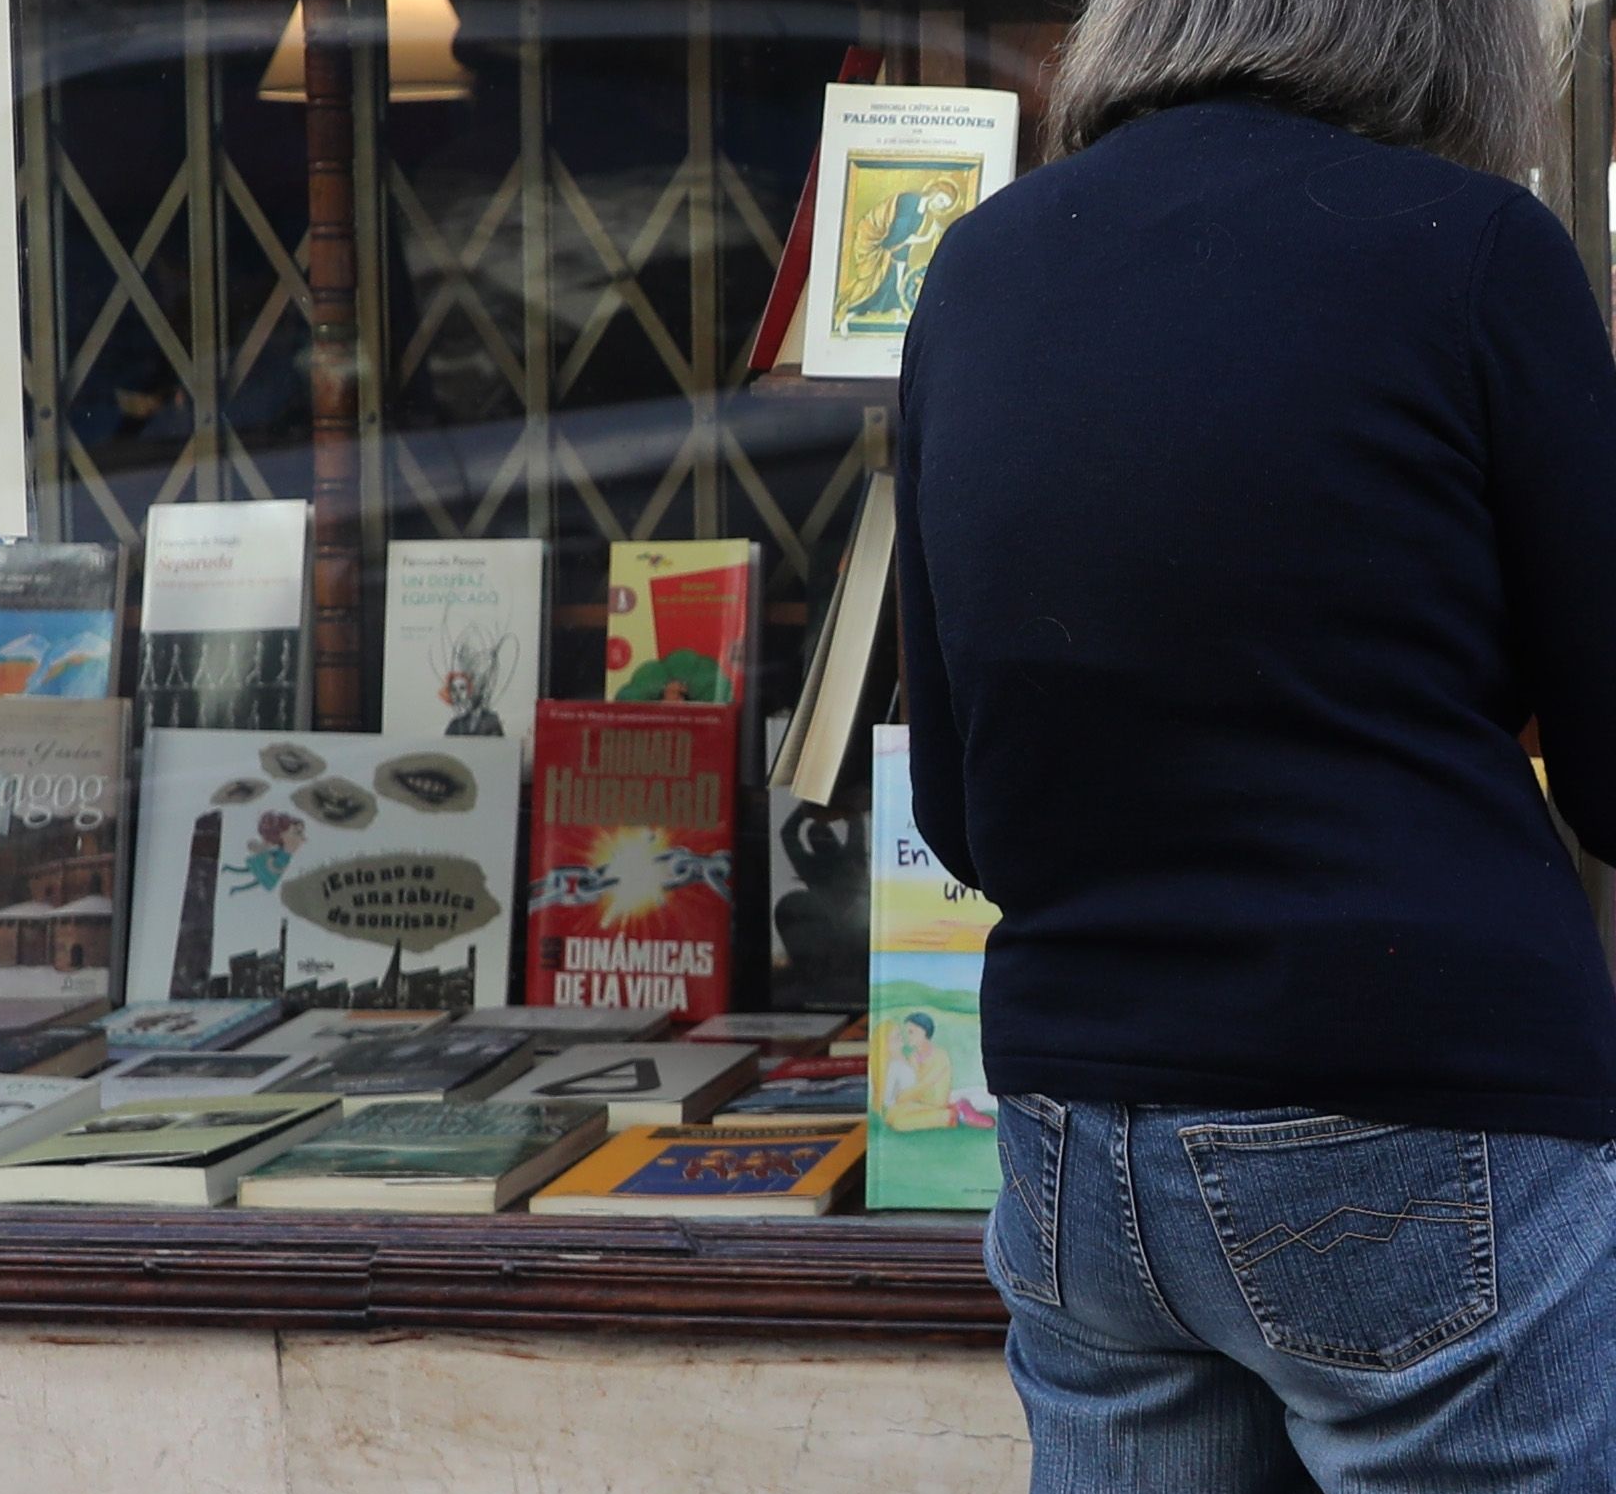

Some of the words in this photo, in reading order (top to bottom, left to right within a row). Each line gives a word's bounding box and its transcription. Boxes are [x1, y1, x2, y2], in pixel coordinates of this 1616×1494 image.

[842, 113, 897, 127] FALSOS
[899, 114, 996, 129] CRONICONES
[600, 728, 692, 774] RONALD
[897, 839, 930, 868] En
[322, 867, 376, 899] ¡Esto
[379, 866, 402, 881] no
[411, 864, 437, 880] es
[352, 889, 393, 907] una
[397, 885, 475, 912] fábrica
[327, 907, 352, 925] de
[355, 912, 459, 931] sonrisas!
[564, 931, 716, 975] DINÁMICAS
[553, 970, 586, 1007] DE
[590, 973, 620, 1008] LA
[625, 975, 689, 1011] VIDA
